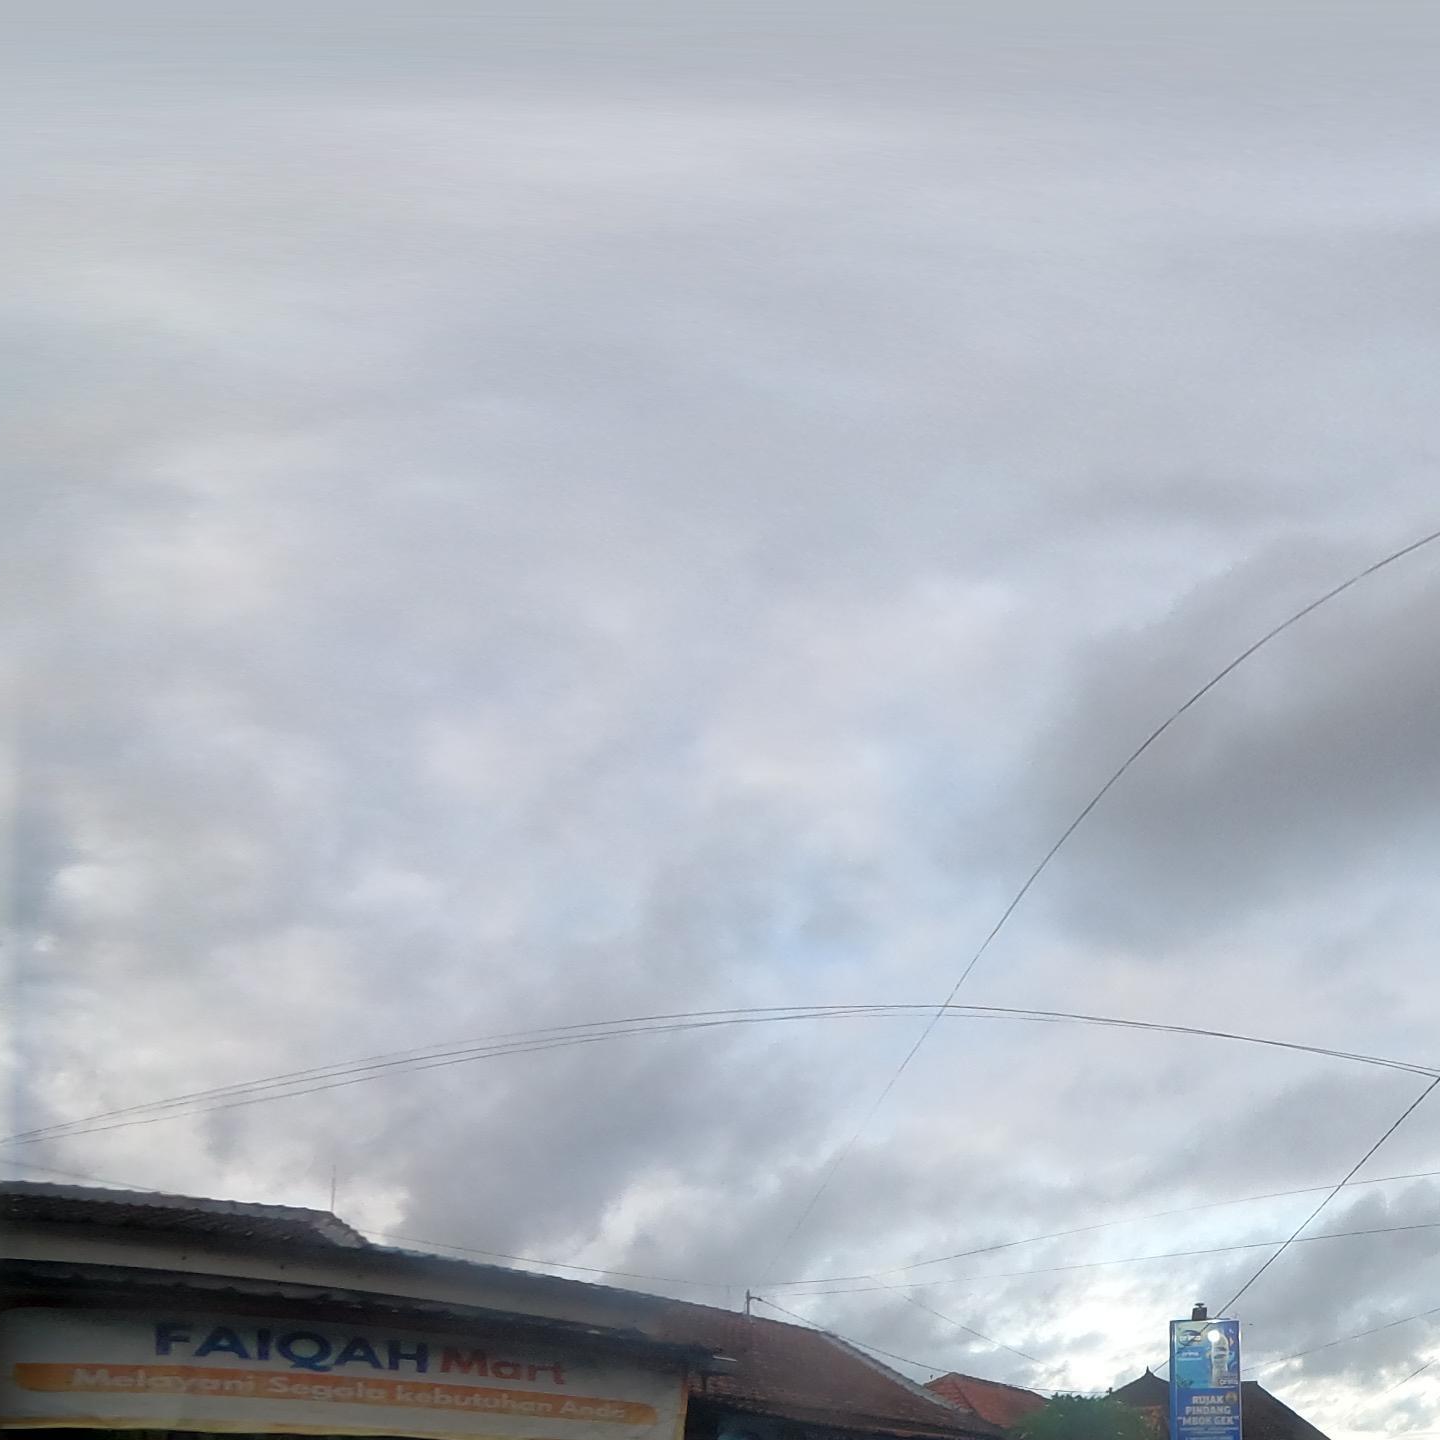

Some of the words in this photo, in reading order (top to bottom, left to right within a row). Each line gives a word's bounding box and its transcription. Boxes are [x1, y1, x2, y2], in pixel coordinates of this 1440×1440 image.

[155, 1322, 429, 1373] FAIQAH
[440, 1348, 565, 1385] Mart
[72, 1368, 256, 1394] Melayani
[269, 1377, 387, 1401] Segala
[1192, 1395, 1224, 1404] RUJAK
[1185, 1406, 1231, 1415] PINDANG
